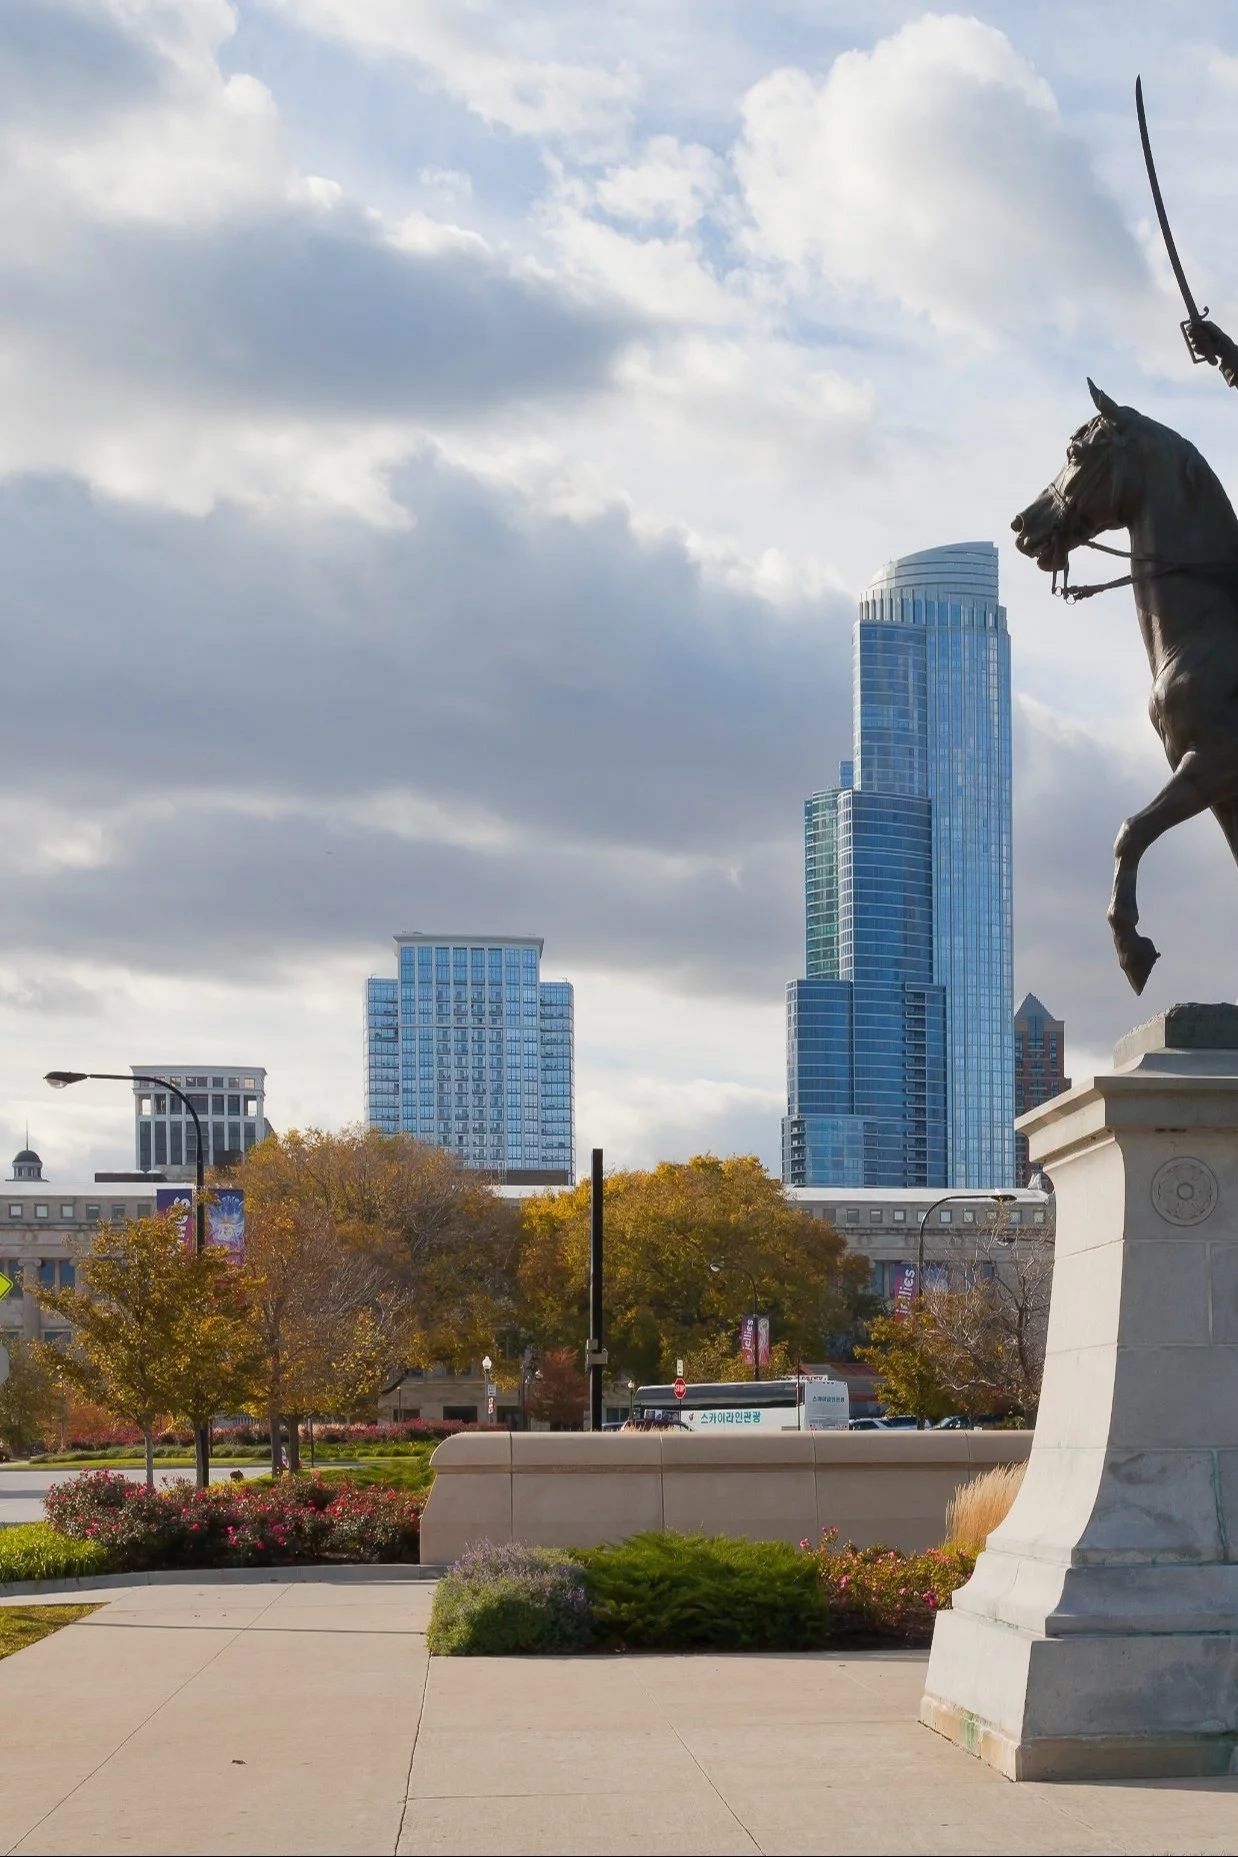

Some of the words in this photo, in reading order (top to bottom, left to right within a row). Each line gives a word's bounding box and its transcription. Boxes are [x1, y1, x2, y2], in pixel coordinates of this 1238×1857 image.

[743, 1319, 754, 1353] jellies
[674, 1384, 686, 1393] STOP
[700, 1411, 761, 1424] 스카이라인관광
